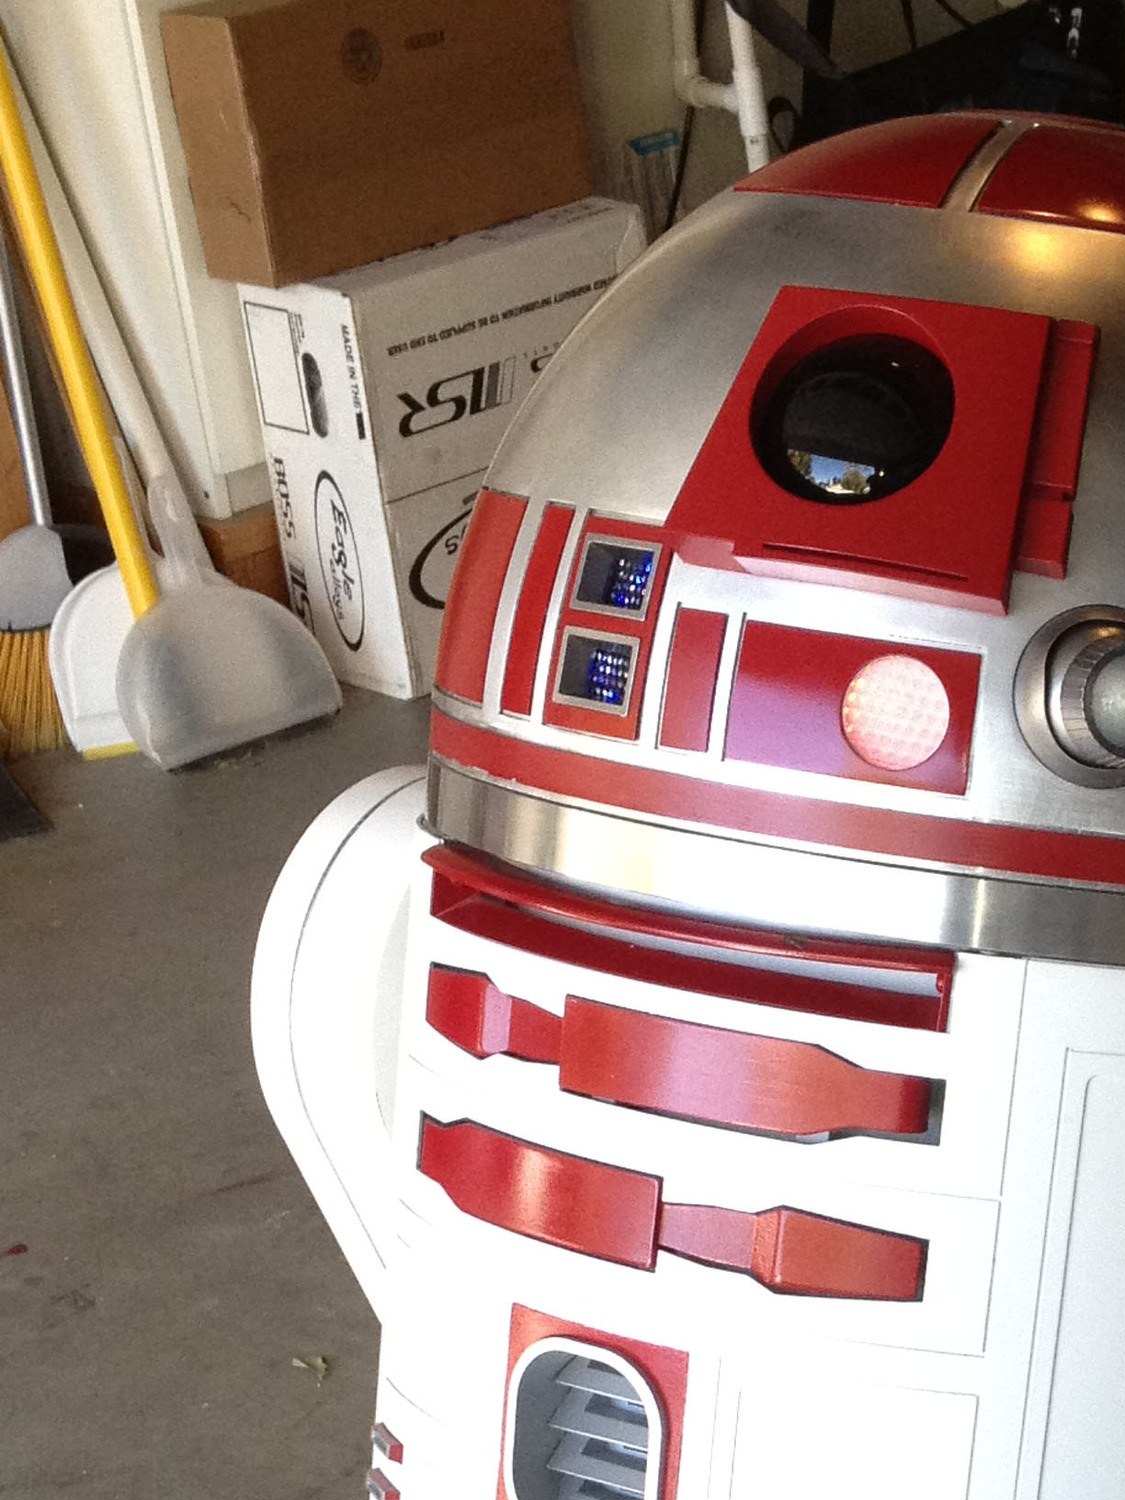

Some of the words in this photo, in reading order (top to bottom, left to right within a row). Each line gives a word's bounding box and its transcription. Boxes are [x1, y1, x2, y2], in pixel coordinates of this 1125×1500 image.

[341, 324, 355, 363] MADE
[348, 366, 357, 380] IN
[273, 457, 297, 539] BOSS
[330, 499, 355, 601] Eagle
